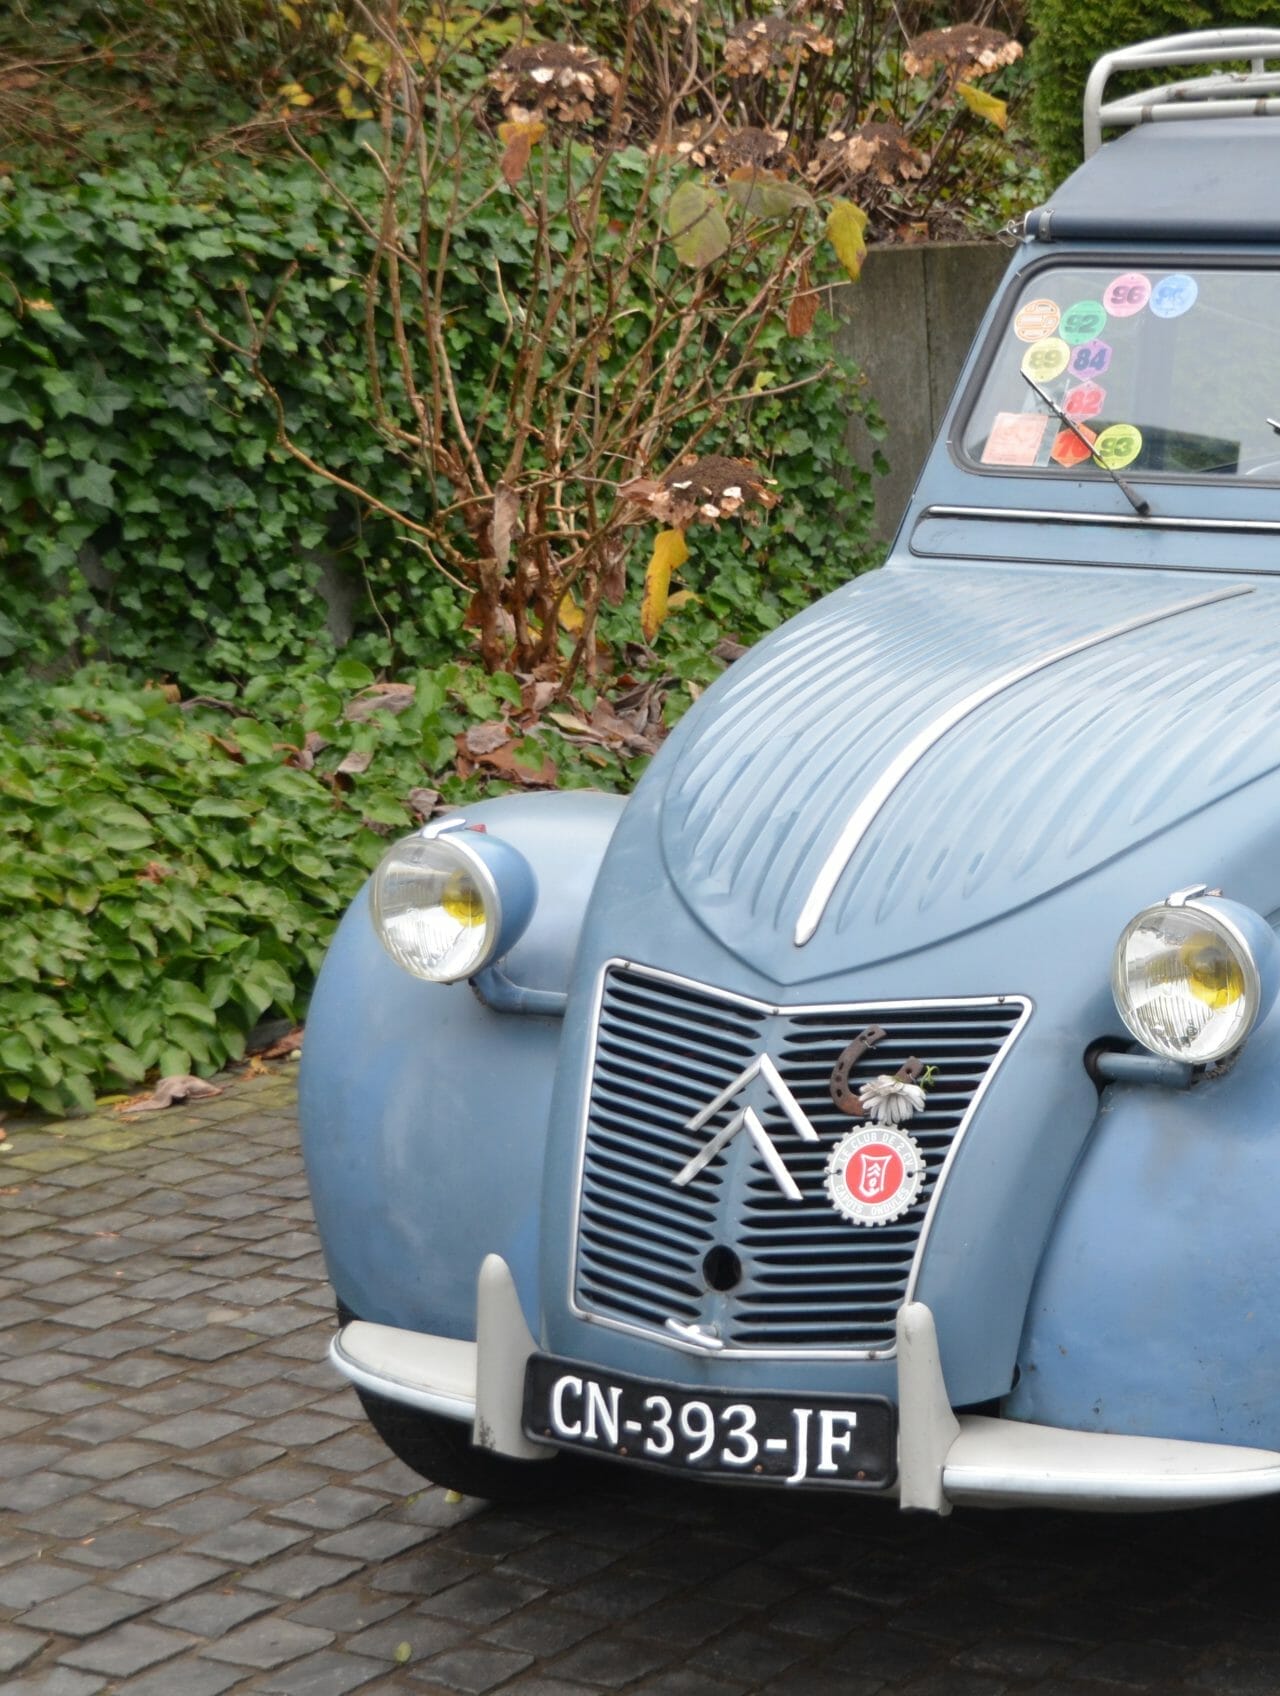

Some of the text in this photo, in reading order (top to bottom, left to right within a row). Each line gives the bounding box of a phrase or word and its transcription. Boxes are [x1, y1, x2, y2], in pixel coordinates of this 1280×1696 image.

[1111, 286, 1146, 304] 96
[1064, 315, 1099, 333] 92
[1073, 348, 1107, 371] 84
[1066, 391, 1102, 414] 82
[1100, 437, 1135, 458] 93
[851, 1133, 877, 1148] CLUB
[882, 1133, 896, 1144] DE
[551, 1375, 857, 1483] CN-393-JF
